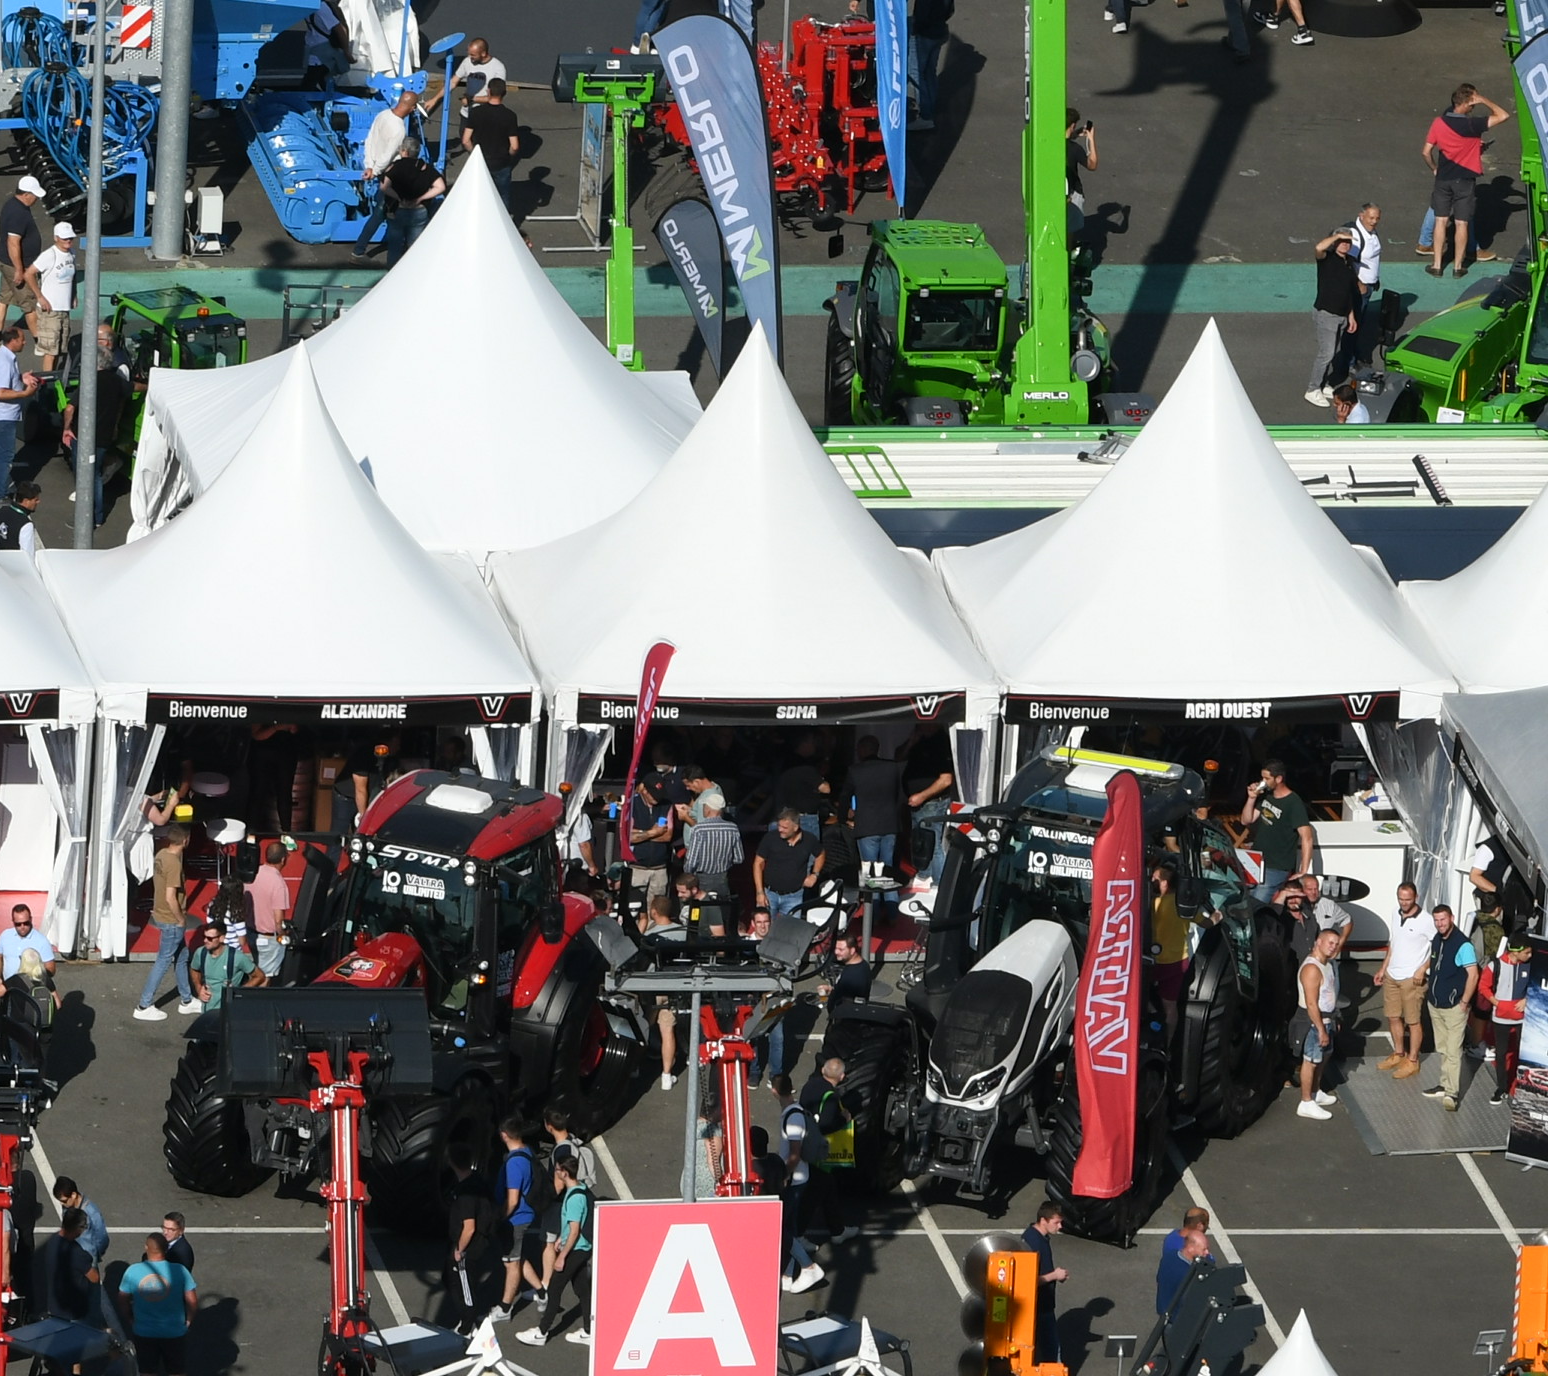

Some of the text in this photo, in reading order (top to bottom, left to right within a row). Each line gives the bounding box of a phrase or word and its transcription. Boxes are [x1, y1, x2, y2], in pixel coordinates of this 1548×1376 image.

[1023, 391, 1069, 400] MERLO
[169, 700, 407, 719] Bienvenue ALEXANDRE
[775, 705, 817, 719] SDMA
[1030, 701, 1271, 719] Bienvenue OUEST
[1028, 850, 1048, 867] 10
[1052, 853, 1094, 869] VALTRA
[382, 870, 401, 886] 10
[1027, 866, 1045, 874] ANS
[1050, 866, 1094, 880] UNLIMITED
[405, 873, 445, 890] VALTRA
[381, 886, 398, 894] ANS
[403, 886, 445, 901] UNLIMITED
[613, 1223, 756, 1370] A
